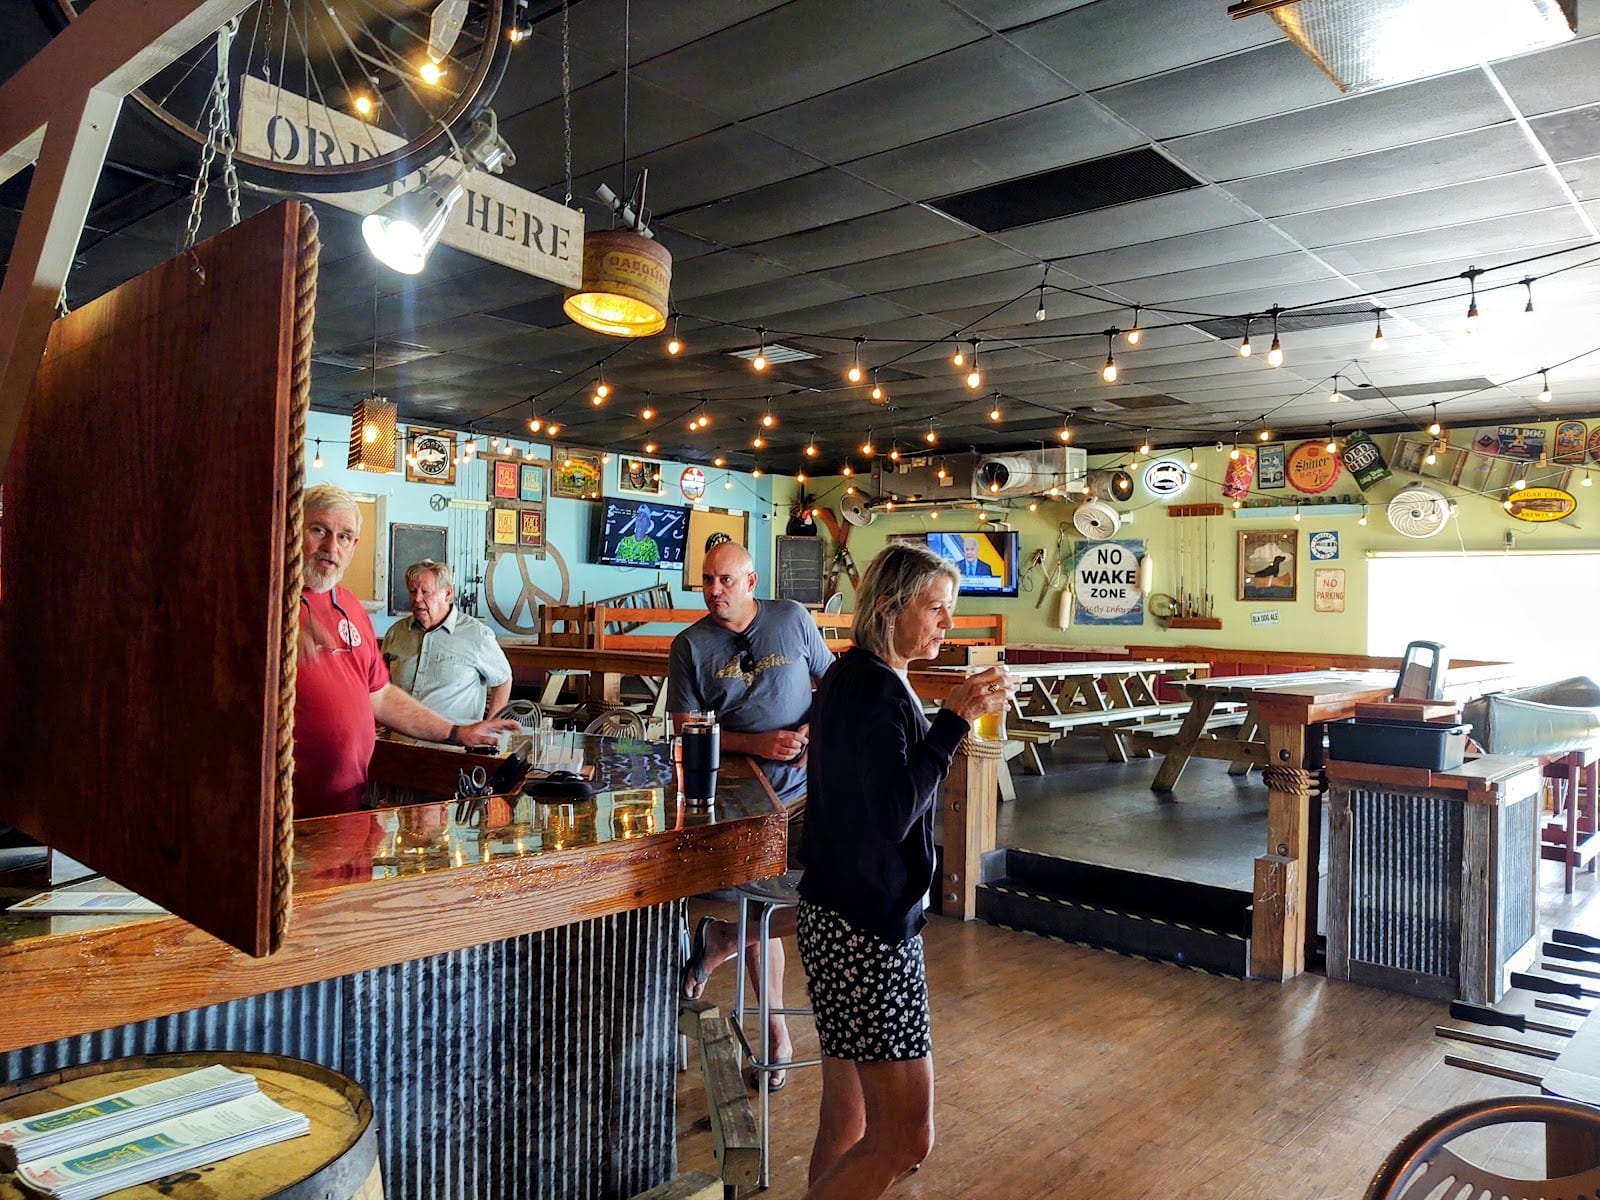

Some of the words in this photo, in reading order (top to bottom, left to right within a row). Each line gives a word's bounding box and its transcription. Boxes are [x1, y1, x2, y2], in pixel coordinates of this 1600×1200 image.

[464, 185, 572, 262] HERE
[1498, 428, 1519, 437] SEA
[1522, 429, 1545, 438] DOG
[1344, 443, 1369, 463] OLD
[1295, 456, 1330, 473] Shiner
[1348, 449, 1379, 473] CHUB
[1097, 548, 1122, 565] NO
[1081, 570, 1137, 584] WAKE
[1323, 579, 1338, 588] NO
[1090, 588, 1127, 599] ZONE
[1316, 591, 1344, 601] PARKING
[1261, 614, 1270, 623] DOG
[1270, 612, 1278, 621] ALE
